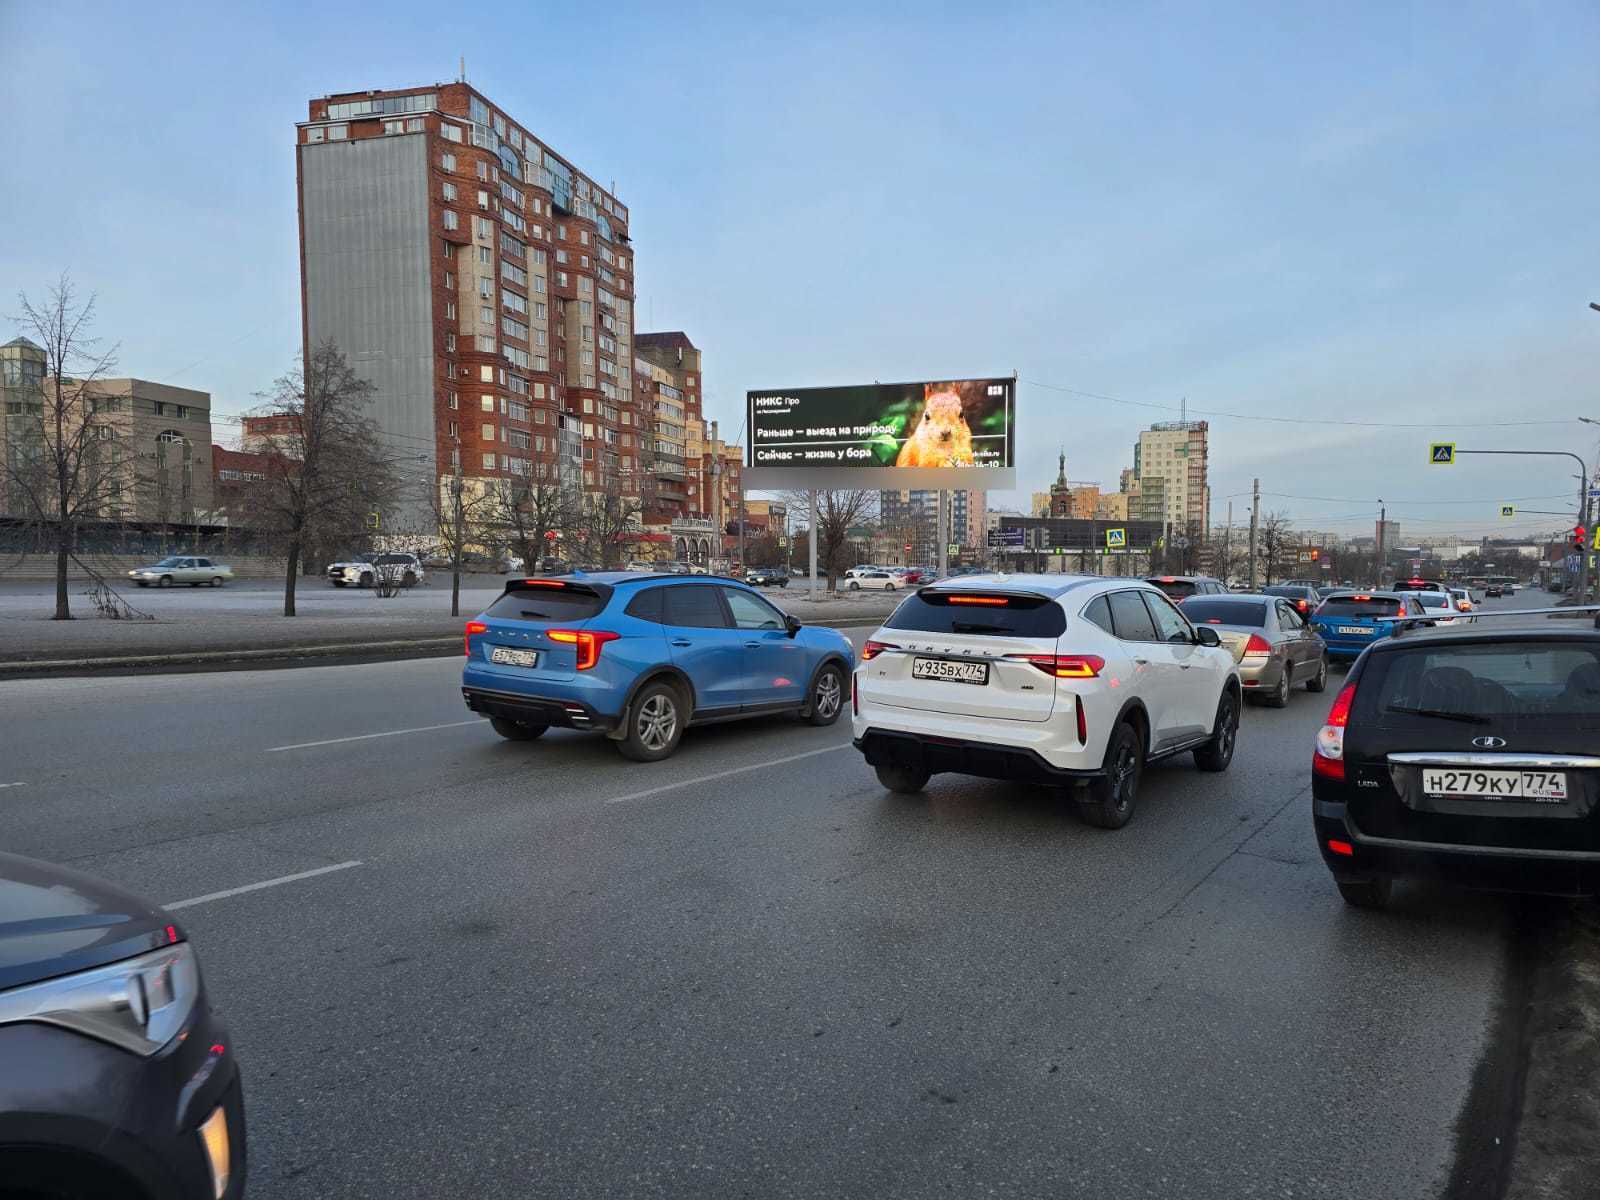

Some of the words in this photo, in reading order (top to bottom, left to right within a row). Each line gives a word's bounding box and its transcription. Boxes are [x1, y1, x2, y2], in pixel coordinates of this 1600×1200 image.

[756, 397, 783, 406] НИКС
[784, 397, 800, 406] Про
[757, 428, 794, 438] Раньше
[806, 427, 837, 437] выезд
[838, 427, 850, 435] на
[852, 424, 897, 435] природу
[757, 449, 792, 460] Сейчас
[805, 450, 835, 459] жизнь
[838, 450, 845, 459] у
[846, 447, 872, 458] бора
[917, 662, 962, 678] У935ВХ
[964, 664, 983, 676] 774
[1430, 772, 1518, 793] Н279КУ
[1523, 774, 1560, 790] 774
